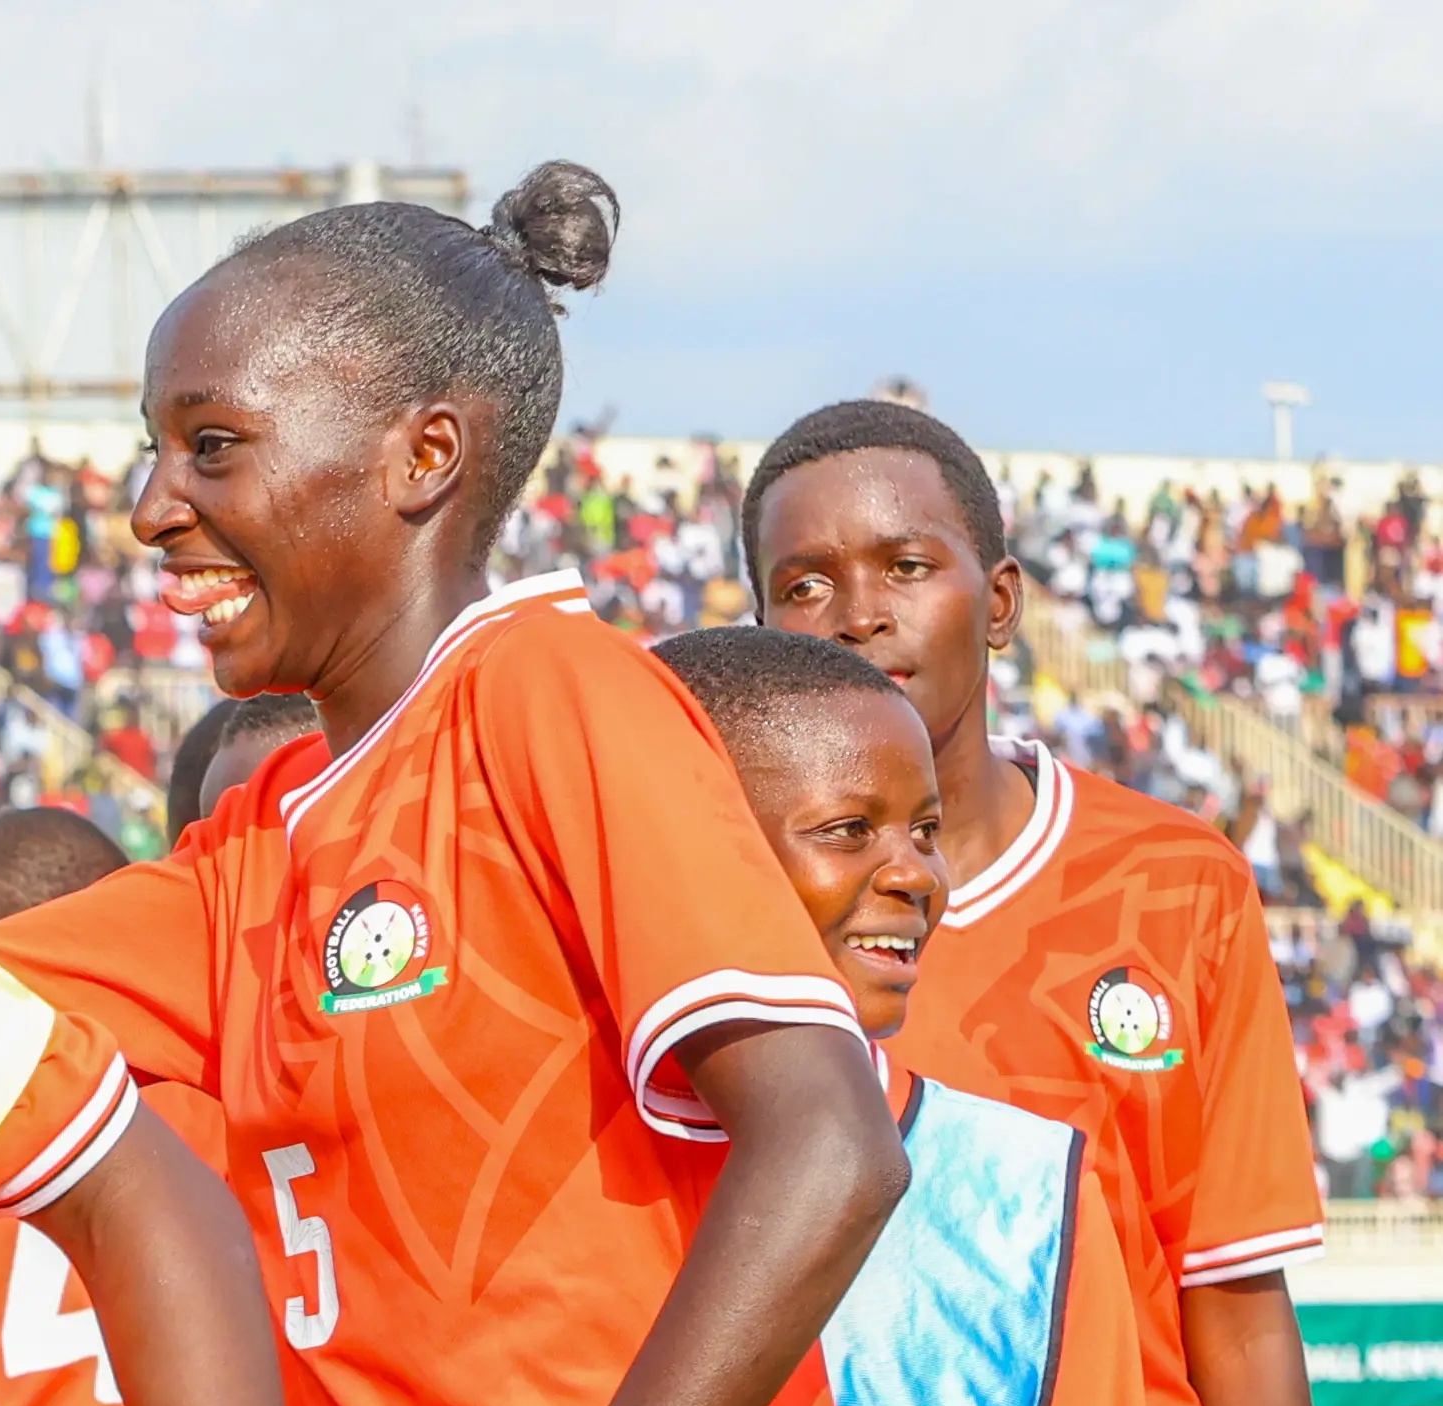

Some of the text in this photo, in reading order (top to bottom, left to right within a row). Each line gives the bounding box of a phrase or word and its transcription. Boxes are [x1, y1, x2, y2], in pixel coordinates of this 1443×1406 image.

[326, 908, 356, 988] FOOTBALL
[410, 903, 429, 958] KENYA
[333, 982, 422, 1013] FEDERATION
[263, 1143, 340, 1351] 5
